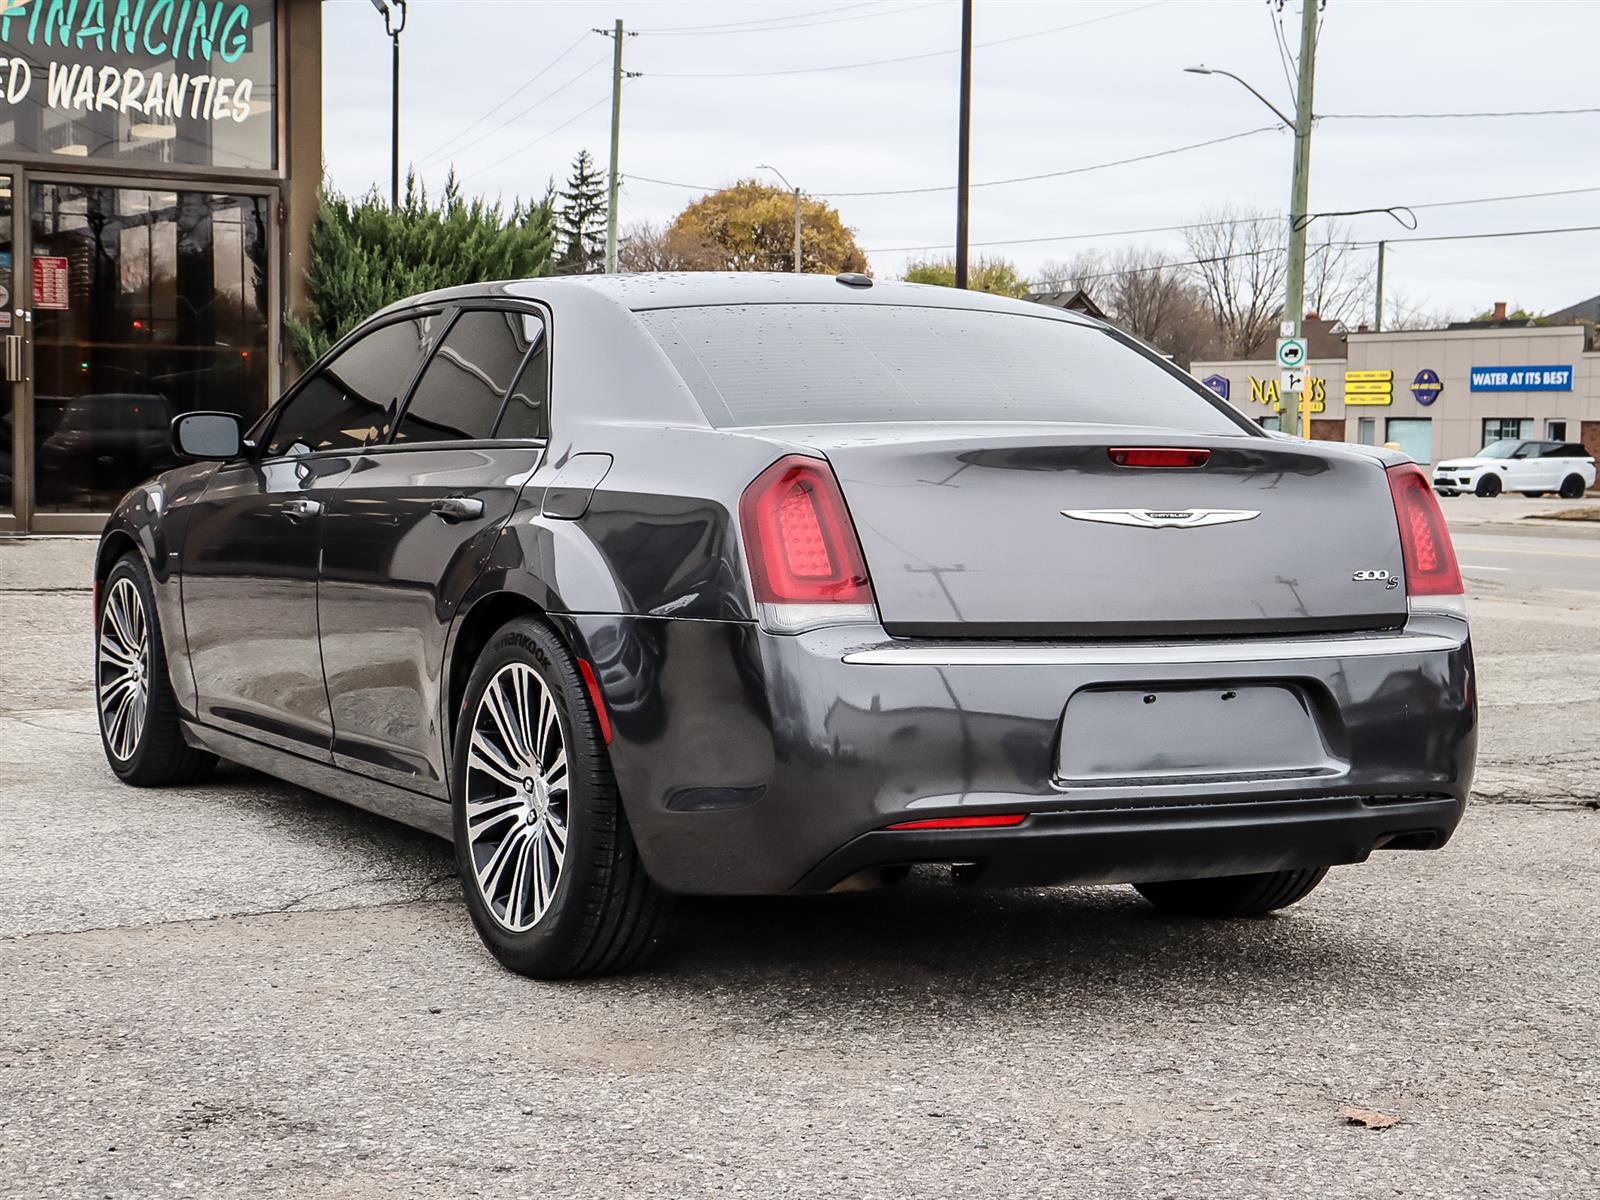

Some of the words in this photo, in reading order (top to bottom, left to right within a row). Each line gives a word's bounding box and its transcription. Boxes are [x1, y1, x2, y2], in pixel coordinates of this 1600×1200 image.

[1, 0, 249, 63] FINANCING
[48, 61, 253, 123] WARRANTIES
[1472, 372, 1508, 386] WATER
[1510, 372, 1524, 385] AT
[1525, 371, 1541, 385] ITS
[1543, 371, 1570, 385] BEST
